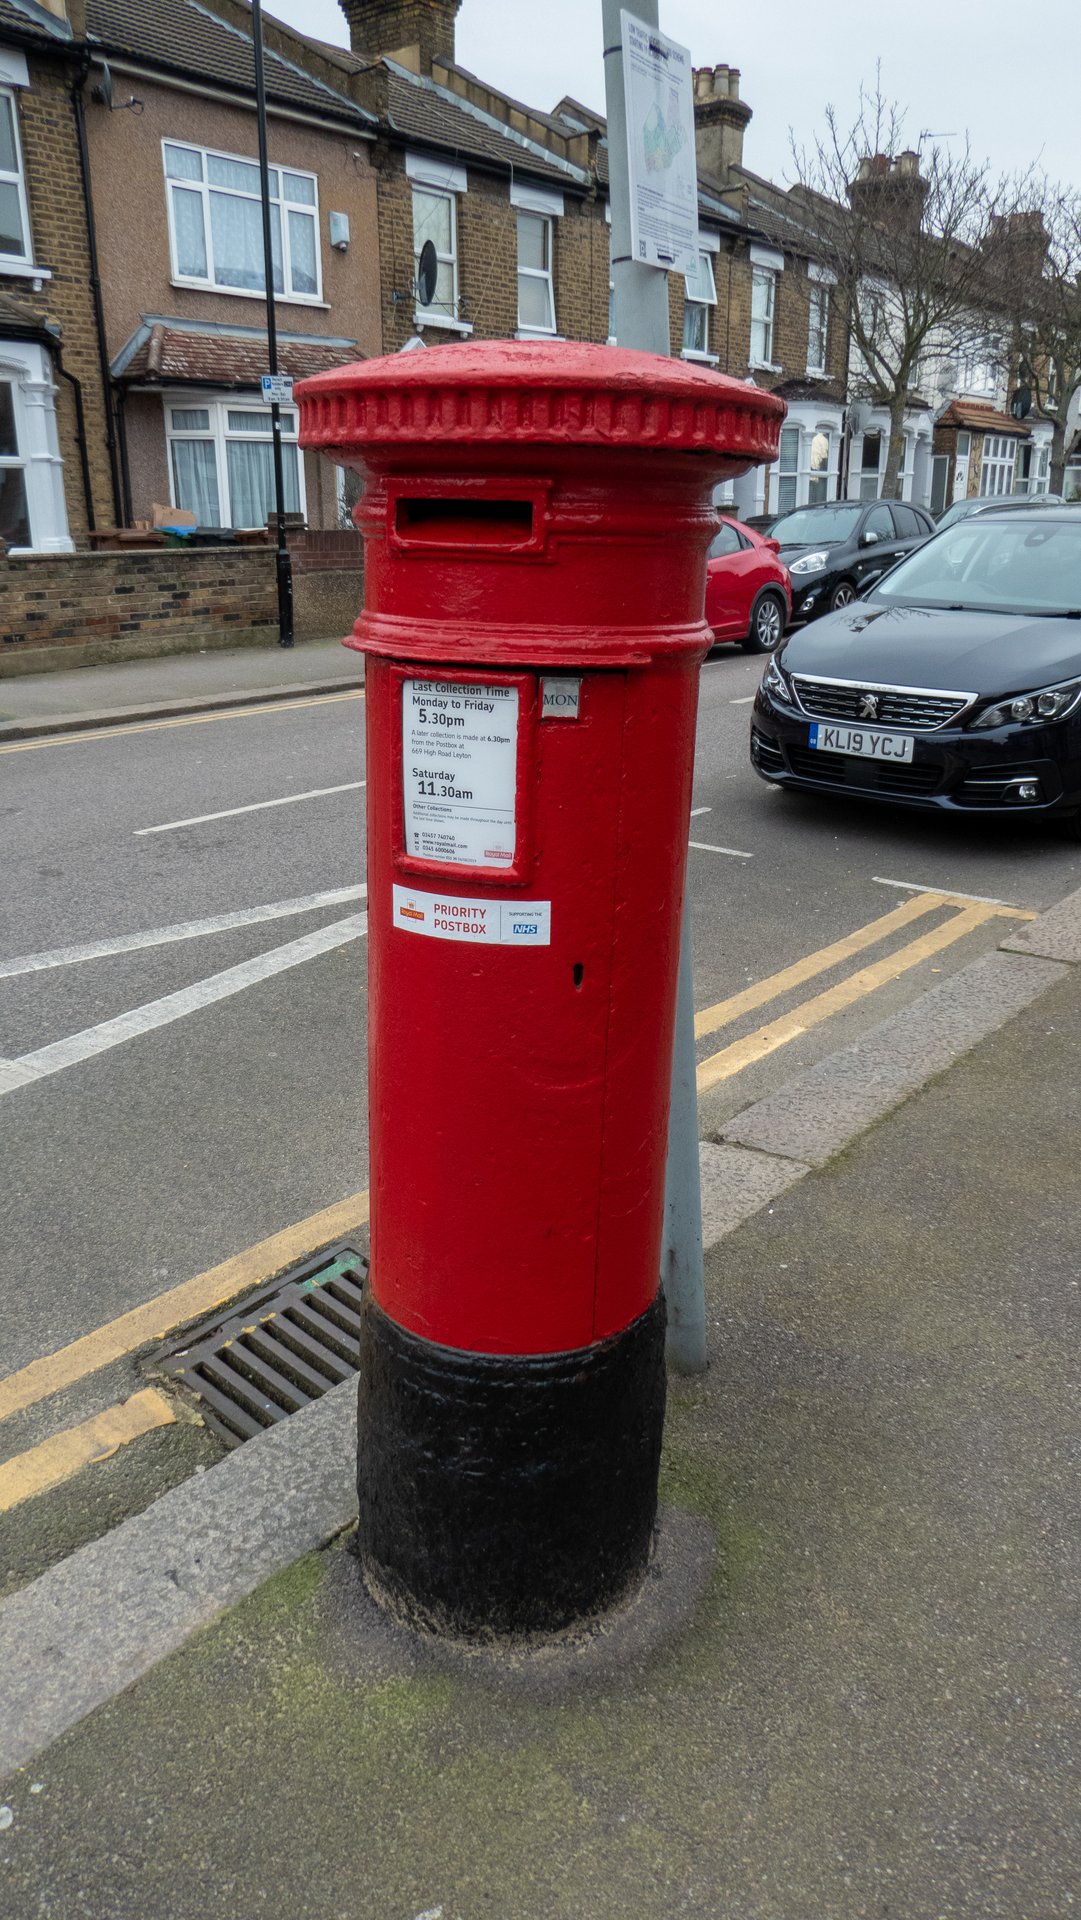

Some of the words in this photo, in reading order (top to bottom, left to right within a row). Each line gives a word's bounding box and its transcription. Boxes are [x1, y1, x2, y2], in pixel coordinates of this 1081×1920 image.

[412, 681, 432, 692] Last
[435, 682, 481, 695] Collection
[485, 686, 510, 697] Time
[412, 696, 448, 709] Monday
[451, 700, 461, 709] to
[464, 700, 494, 713] Friday
[543, 694, 578, 706] MON
[419, 708, 465, 728] 5.30pm
[426, 739, 435, 747] the
[436, 740, 457, 749] Postbox
[430, 731, 455, 739] collection
[487, 735, 511, 745] 6.30pm
[824, 728, 863, 752] KL19
[869, 734, 907, 758] YCJ
[424, 748, 436, 757] High
[453, 751, 472, 760] Leyton
[412, 767, 456, 783] Saturday
[418, 780, 473, 800] 11.30am
[427, 805, 452, 813] Collections
[401, 908, 412, 917] Royal
[412, 911, 424, 920] Mail
[434, 903, 487, 919] PRIORITY
[434, 918, 487, 935] POSTBOX
[514, 924, 537, 934] NHS
